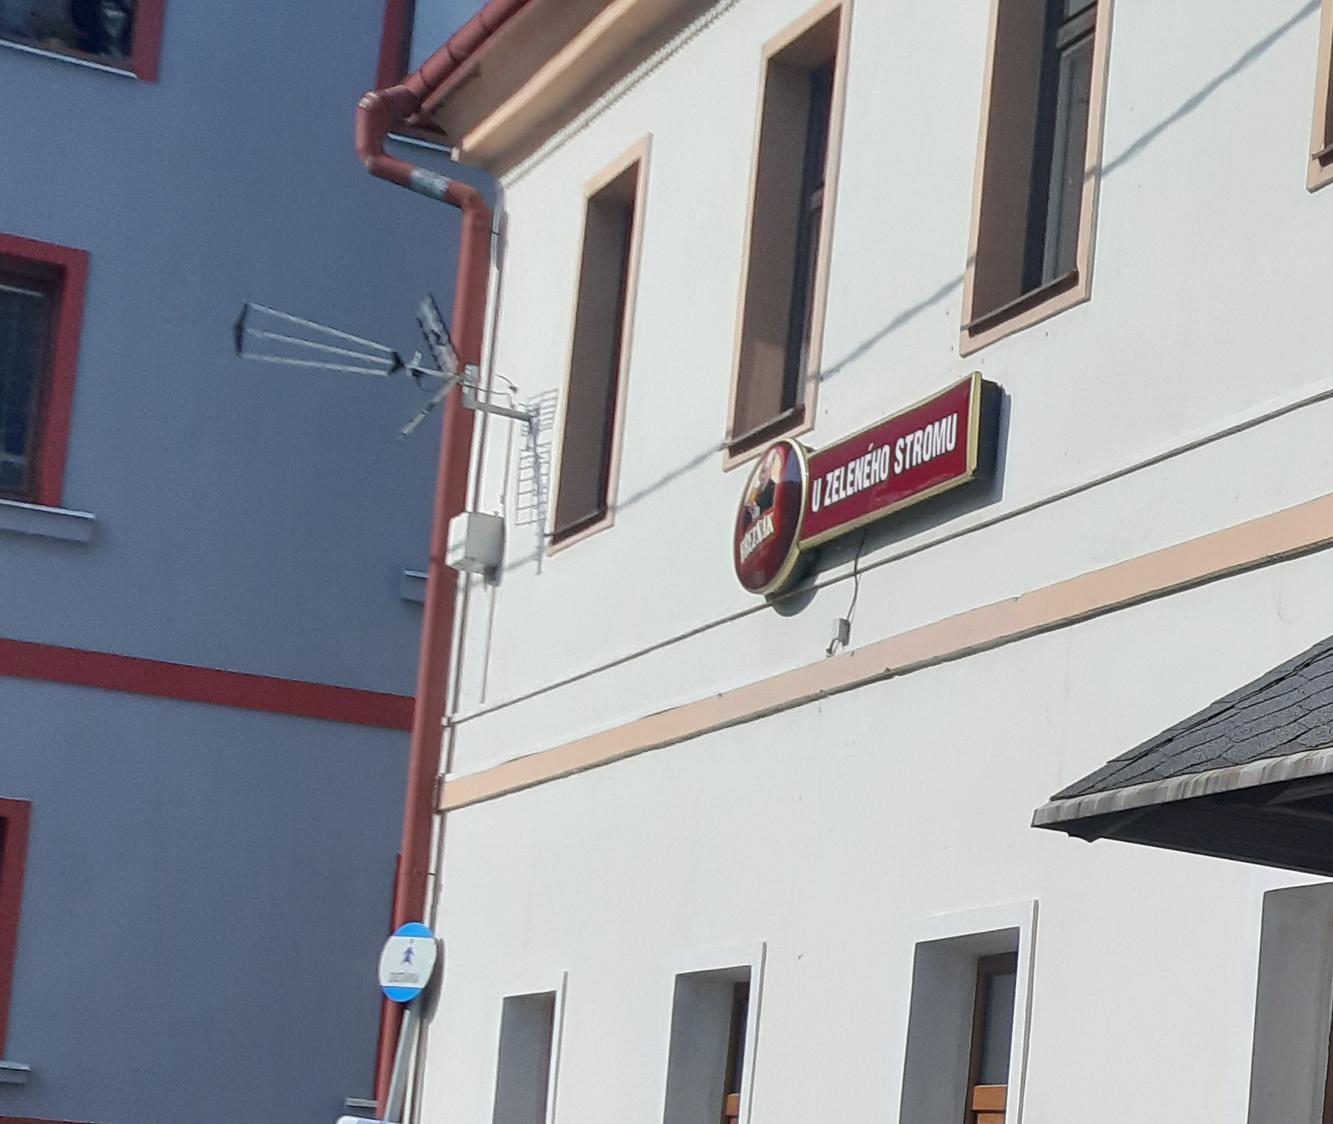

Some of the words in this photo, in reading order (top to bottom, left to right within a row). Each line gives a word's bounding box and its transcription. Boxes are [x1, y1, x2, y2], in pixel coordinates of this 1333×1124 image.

[810, 477, 823, 513] U
[823, 442, 891, 507] ZELENÉHO
[893, 412, 958, 475] STROMU
